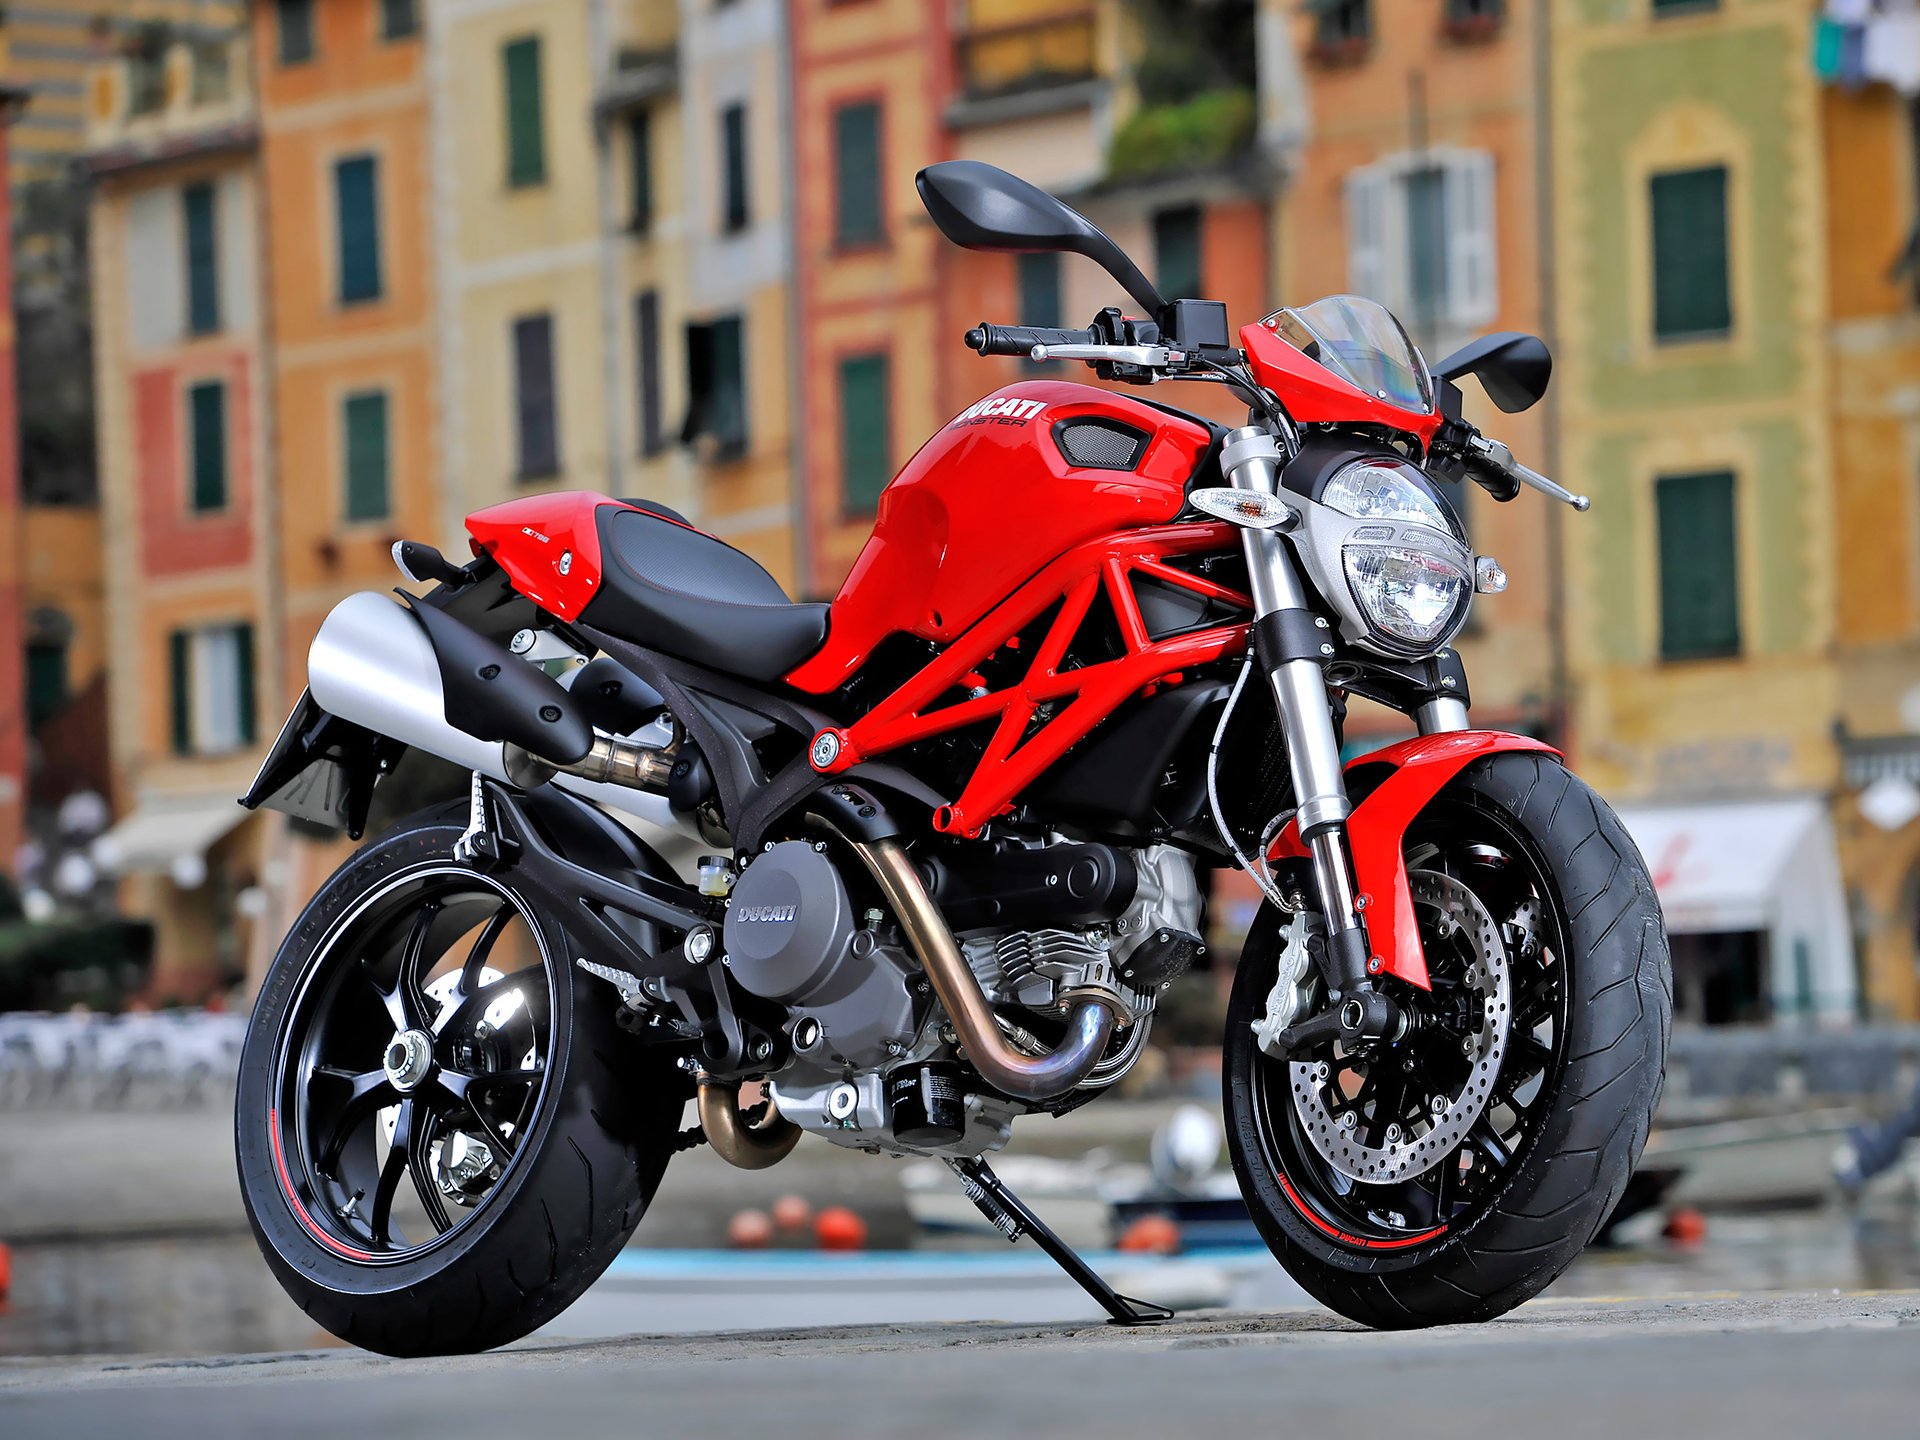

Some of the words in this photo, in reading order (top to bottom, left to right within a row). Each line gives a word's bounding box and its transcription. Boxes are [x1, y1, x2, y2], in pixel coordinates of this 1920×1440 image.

[953, 397, 1048, 424] DUCATI
[737, 905, 797, 922] DUCATI
[1338, 1232, 1368, 1247] DUCATI
